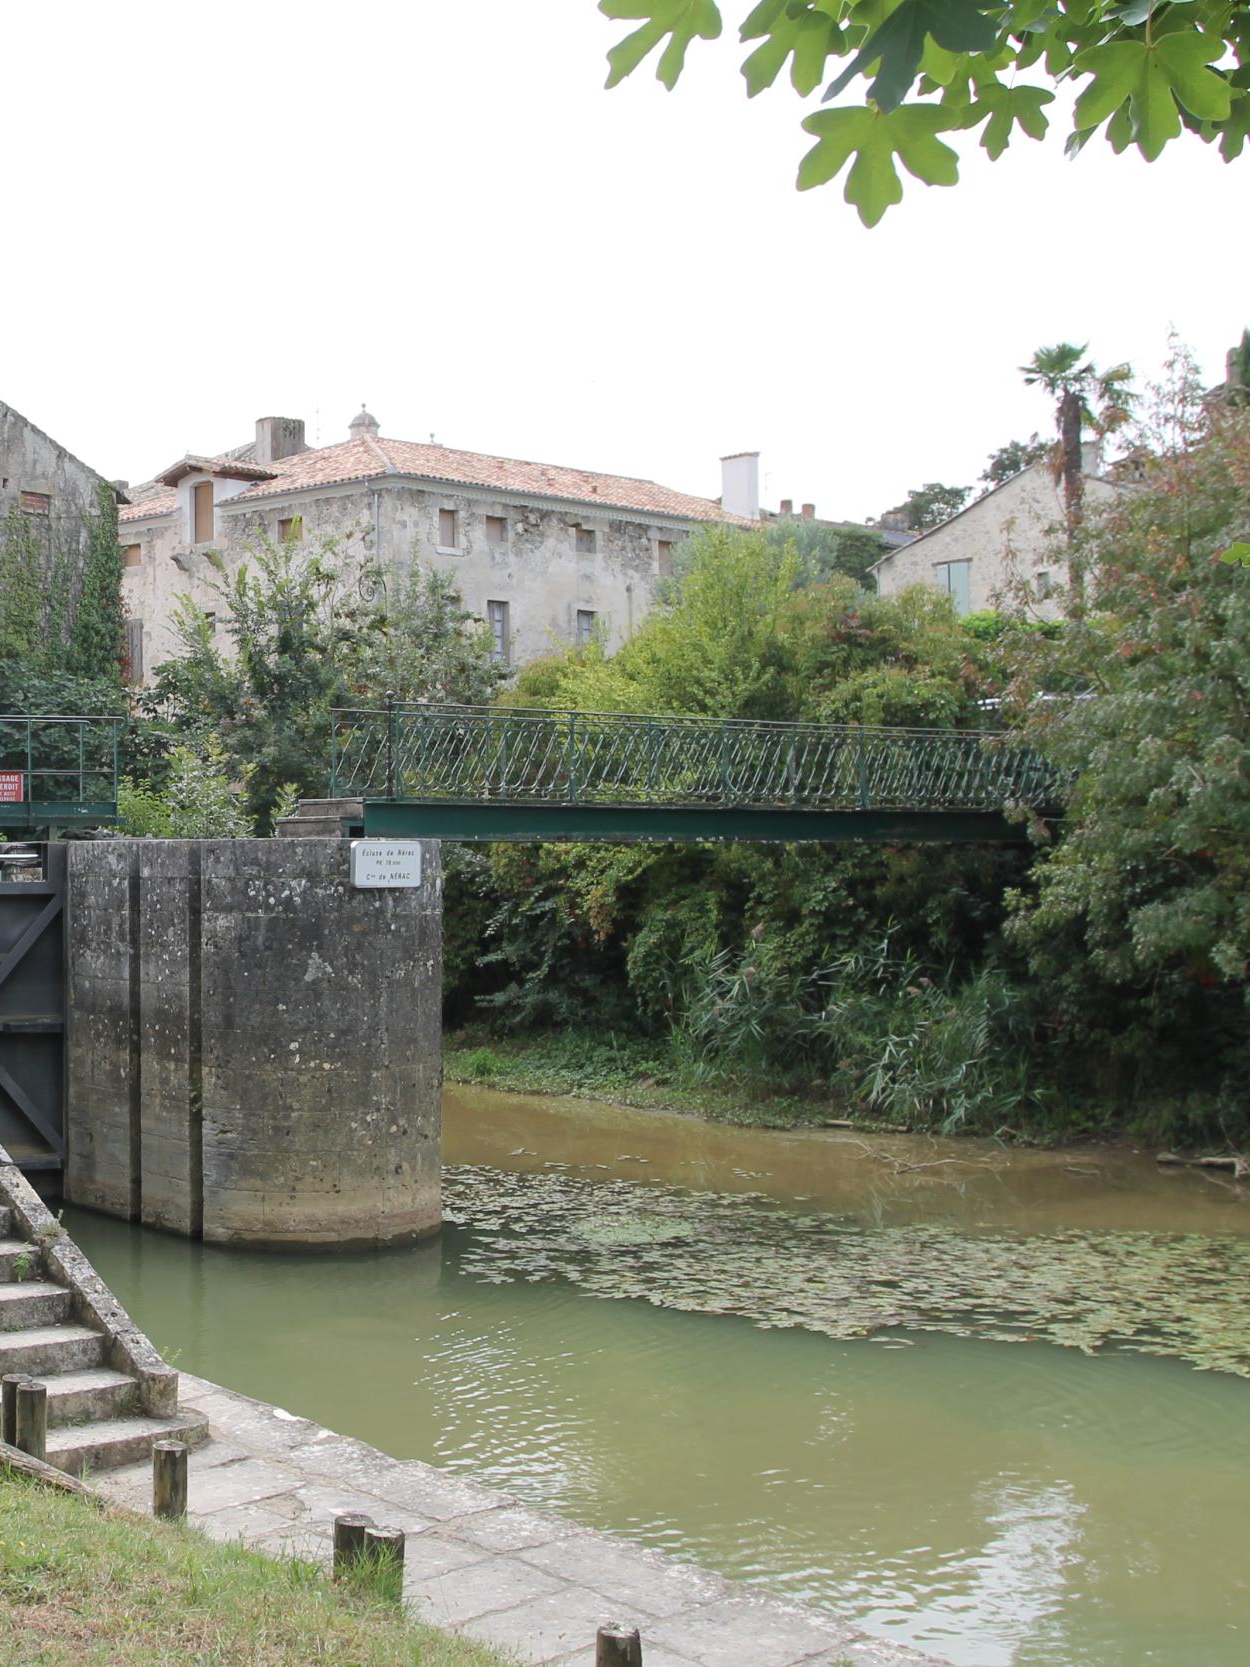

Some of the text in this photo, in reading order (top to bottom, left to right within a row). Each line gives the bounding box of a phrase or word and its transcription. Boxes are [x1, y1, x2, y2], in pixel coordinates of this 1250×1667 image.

[362, 848, 382, 856] Écluse
[398, 848, 414, 856] Nérac
[390, 872, 410, 880] NÉRAC
